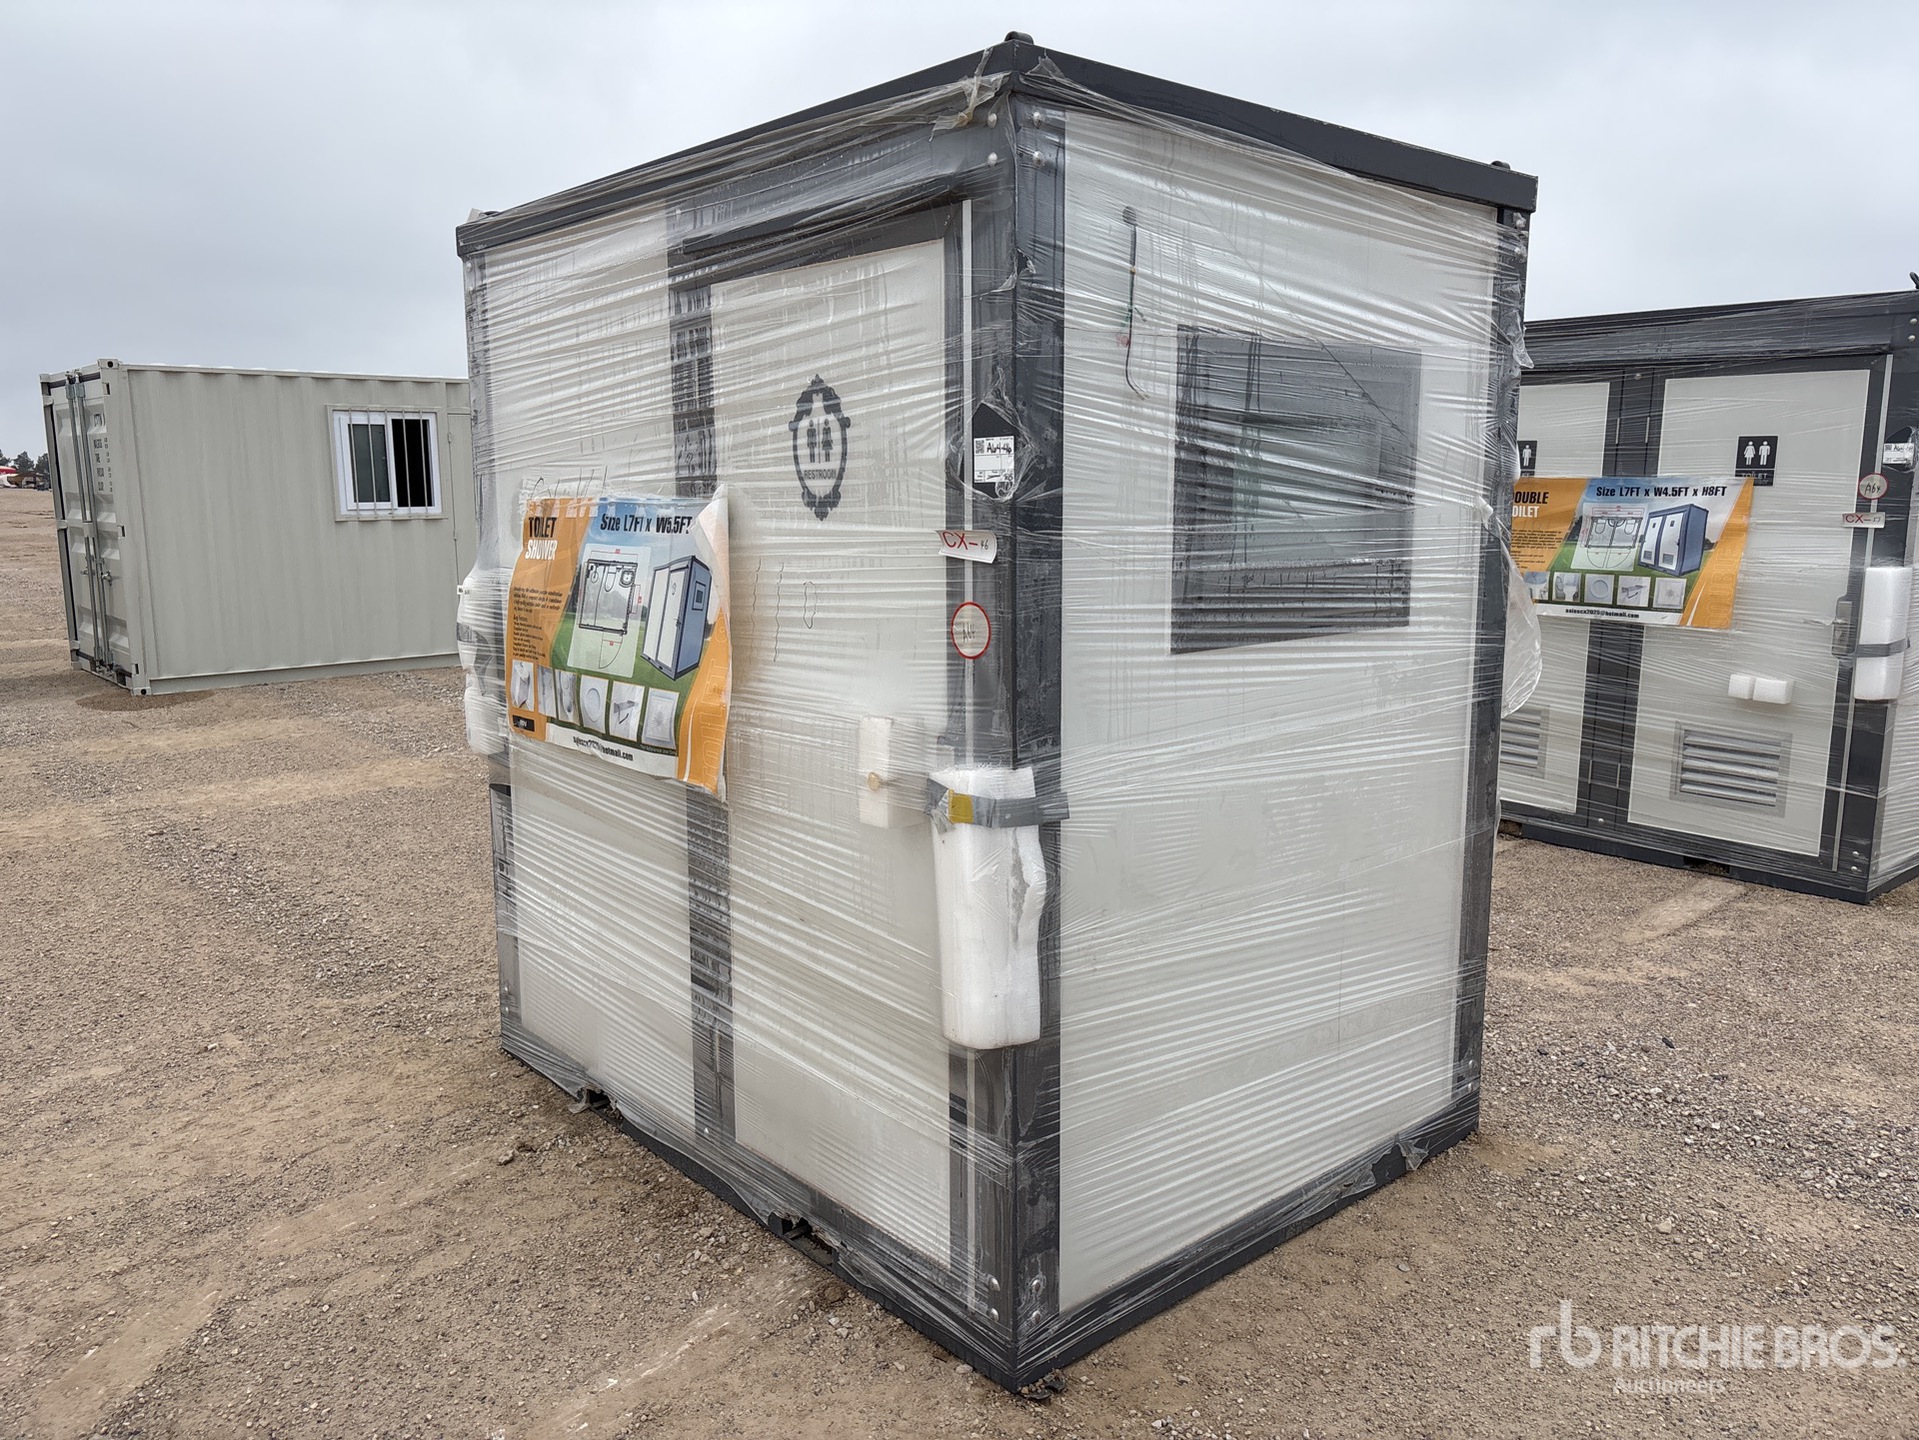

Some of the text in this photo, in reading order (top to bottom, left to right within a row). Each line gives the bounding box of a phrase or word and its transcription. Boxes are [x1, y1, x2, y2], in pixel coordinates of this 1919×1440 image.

[804, 468, 837, 481] RESTROOM
[1512, 490, 1549, 505] OUBLE
[1596, 485, 1728, 498] Size L7FT x W4.5FT x H8FT
[1512, 504, 1540, 518] OILET
[600, 513, 621, 532] Size
[524, 539, 558, 561] SHOWER
